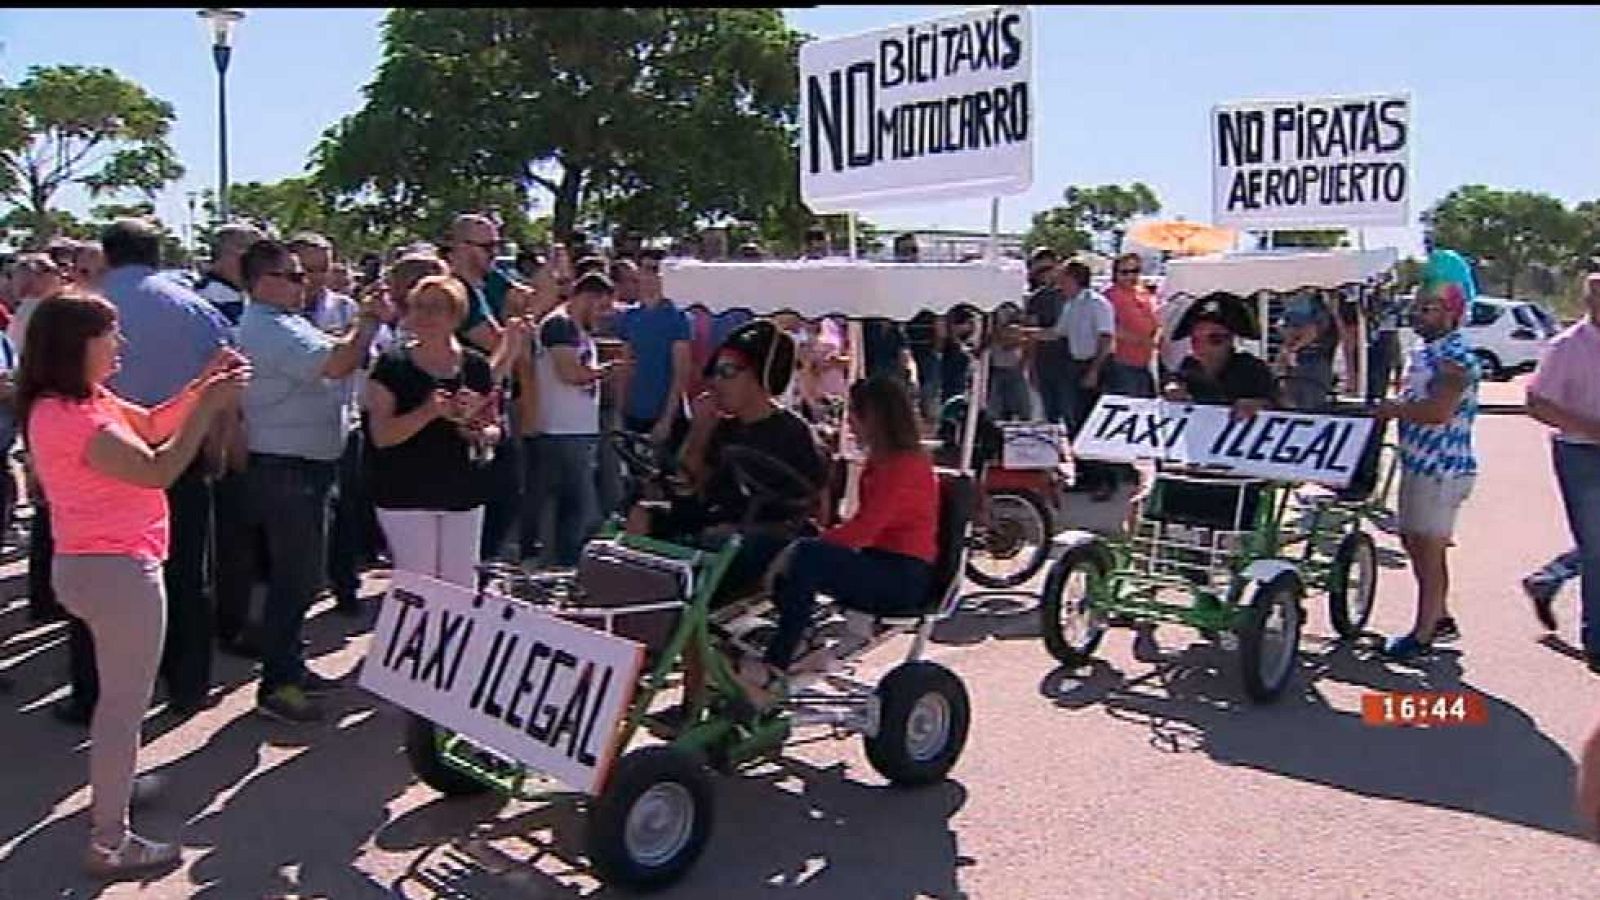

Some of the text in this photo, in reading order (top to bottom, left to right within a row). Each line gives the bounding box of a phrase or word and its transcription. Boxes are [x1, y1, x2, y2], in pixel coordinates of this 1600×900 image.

[808, 62, 875, 174] NO
[877, 82, 1028, 161] MOTOCARRO
[1218, 110, 1264, 166] NO
[1227, 162, 1405, 210] AEROPUERTO
[1211, 416, 1354, 473] ILEGAL
